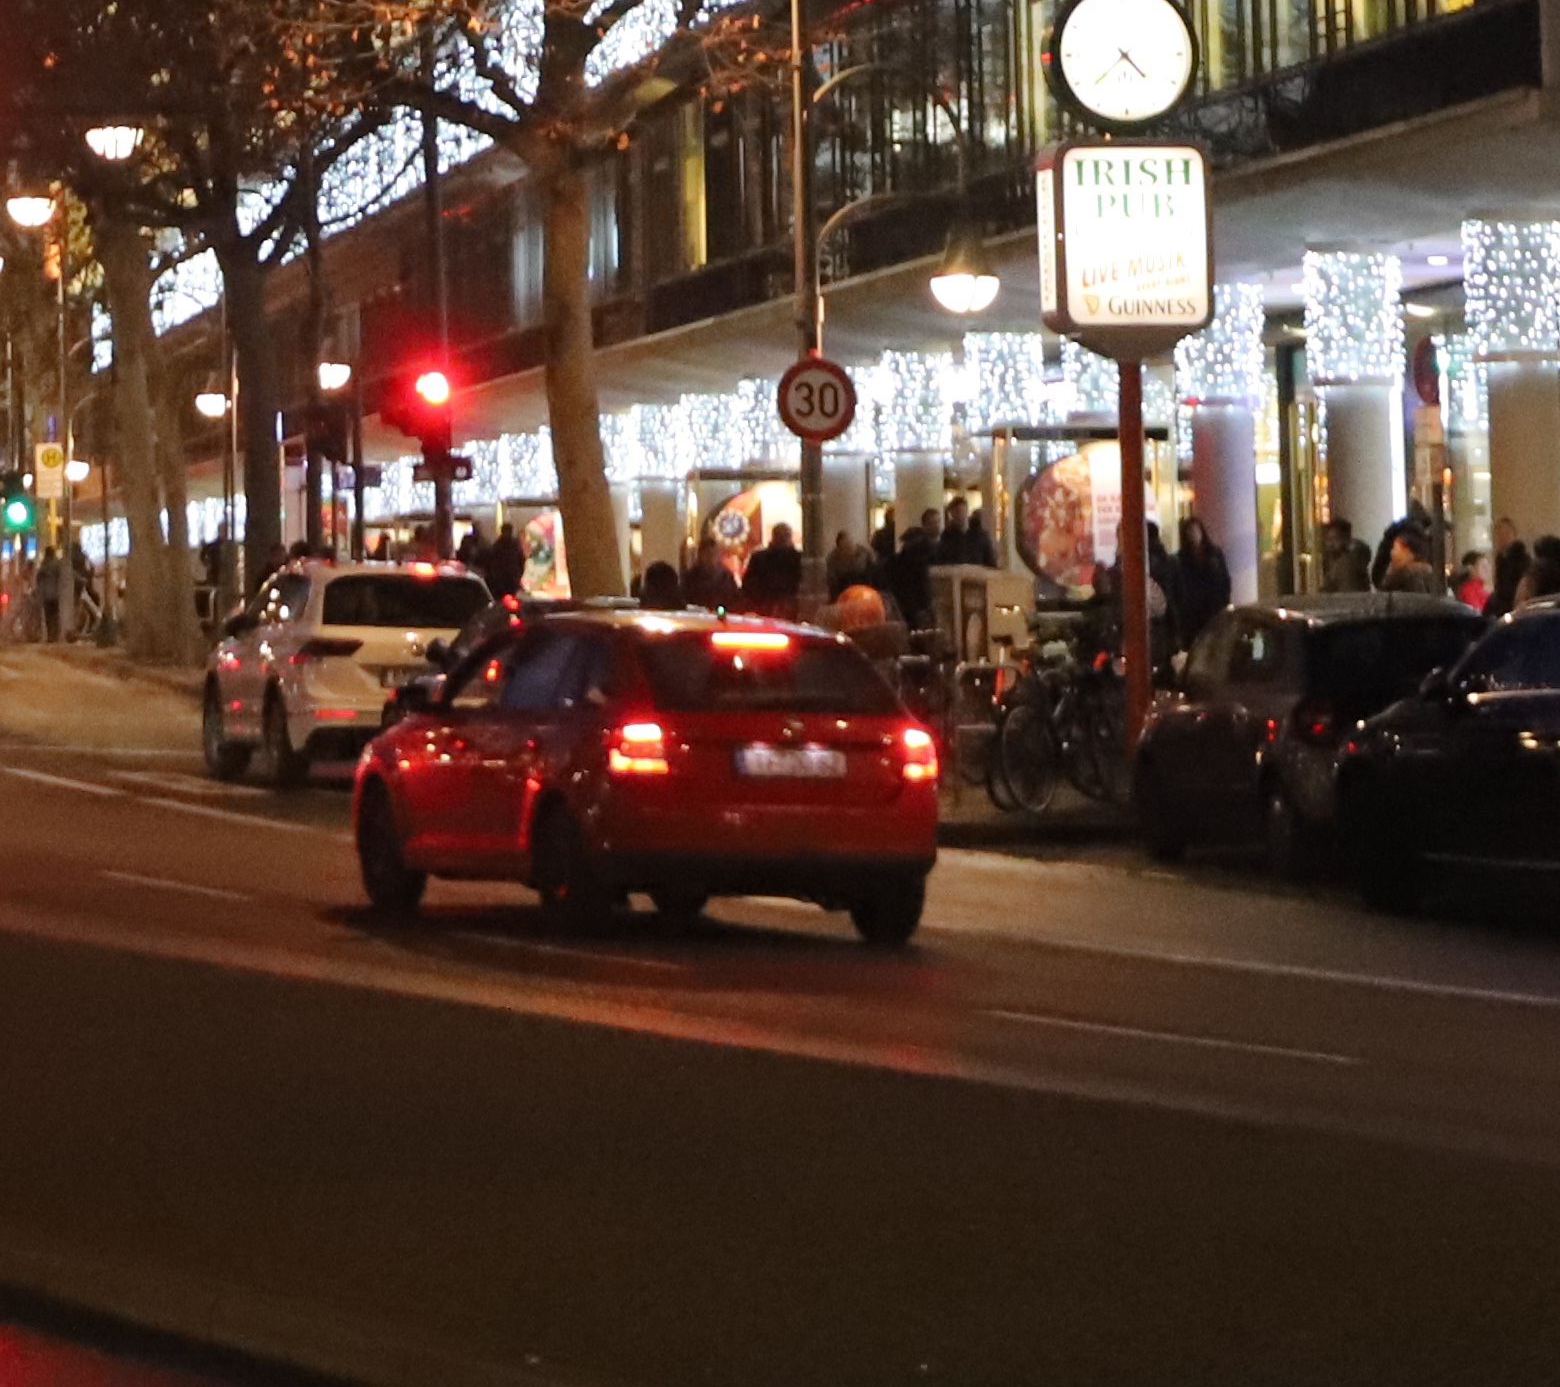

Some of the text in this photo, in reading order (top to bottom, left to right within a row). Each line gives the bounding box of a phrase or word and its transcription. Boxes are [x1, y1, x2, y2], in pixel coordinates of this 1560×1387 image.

[1073, 157, 1193, 187] IRISH
[1096, 193, 1175, 219] PUB
[1082, 250, 1186, 289] LIVE MUSIK
[1108, 296, 1197, 317] GUINNESS
[793, 381, 840, 419] 30
